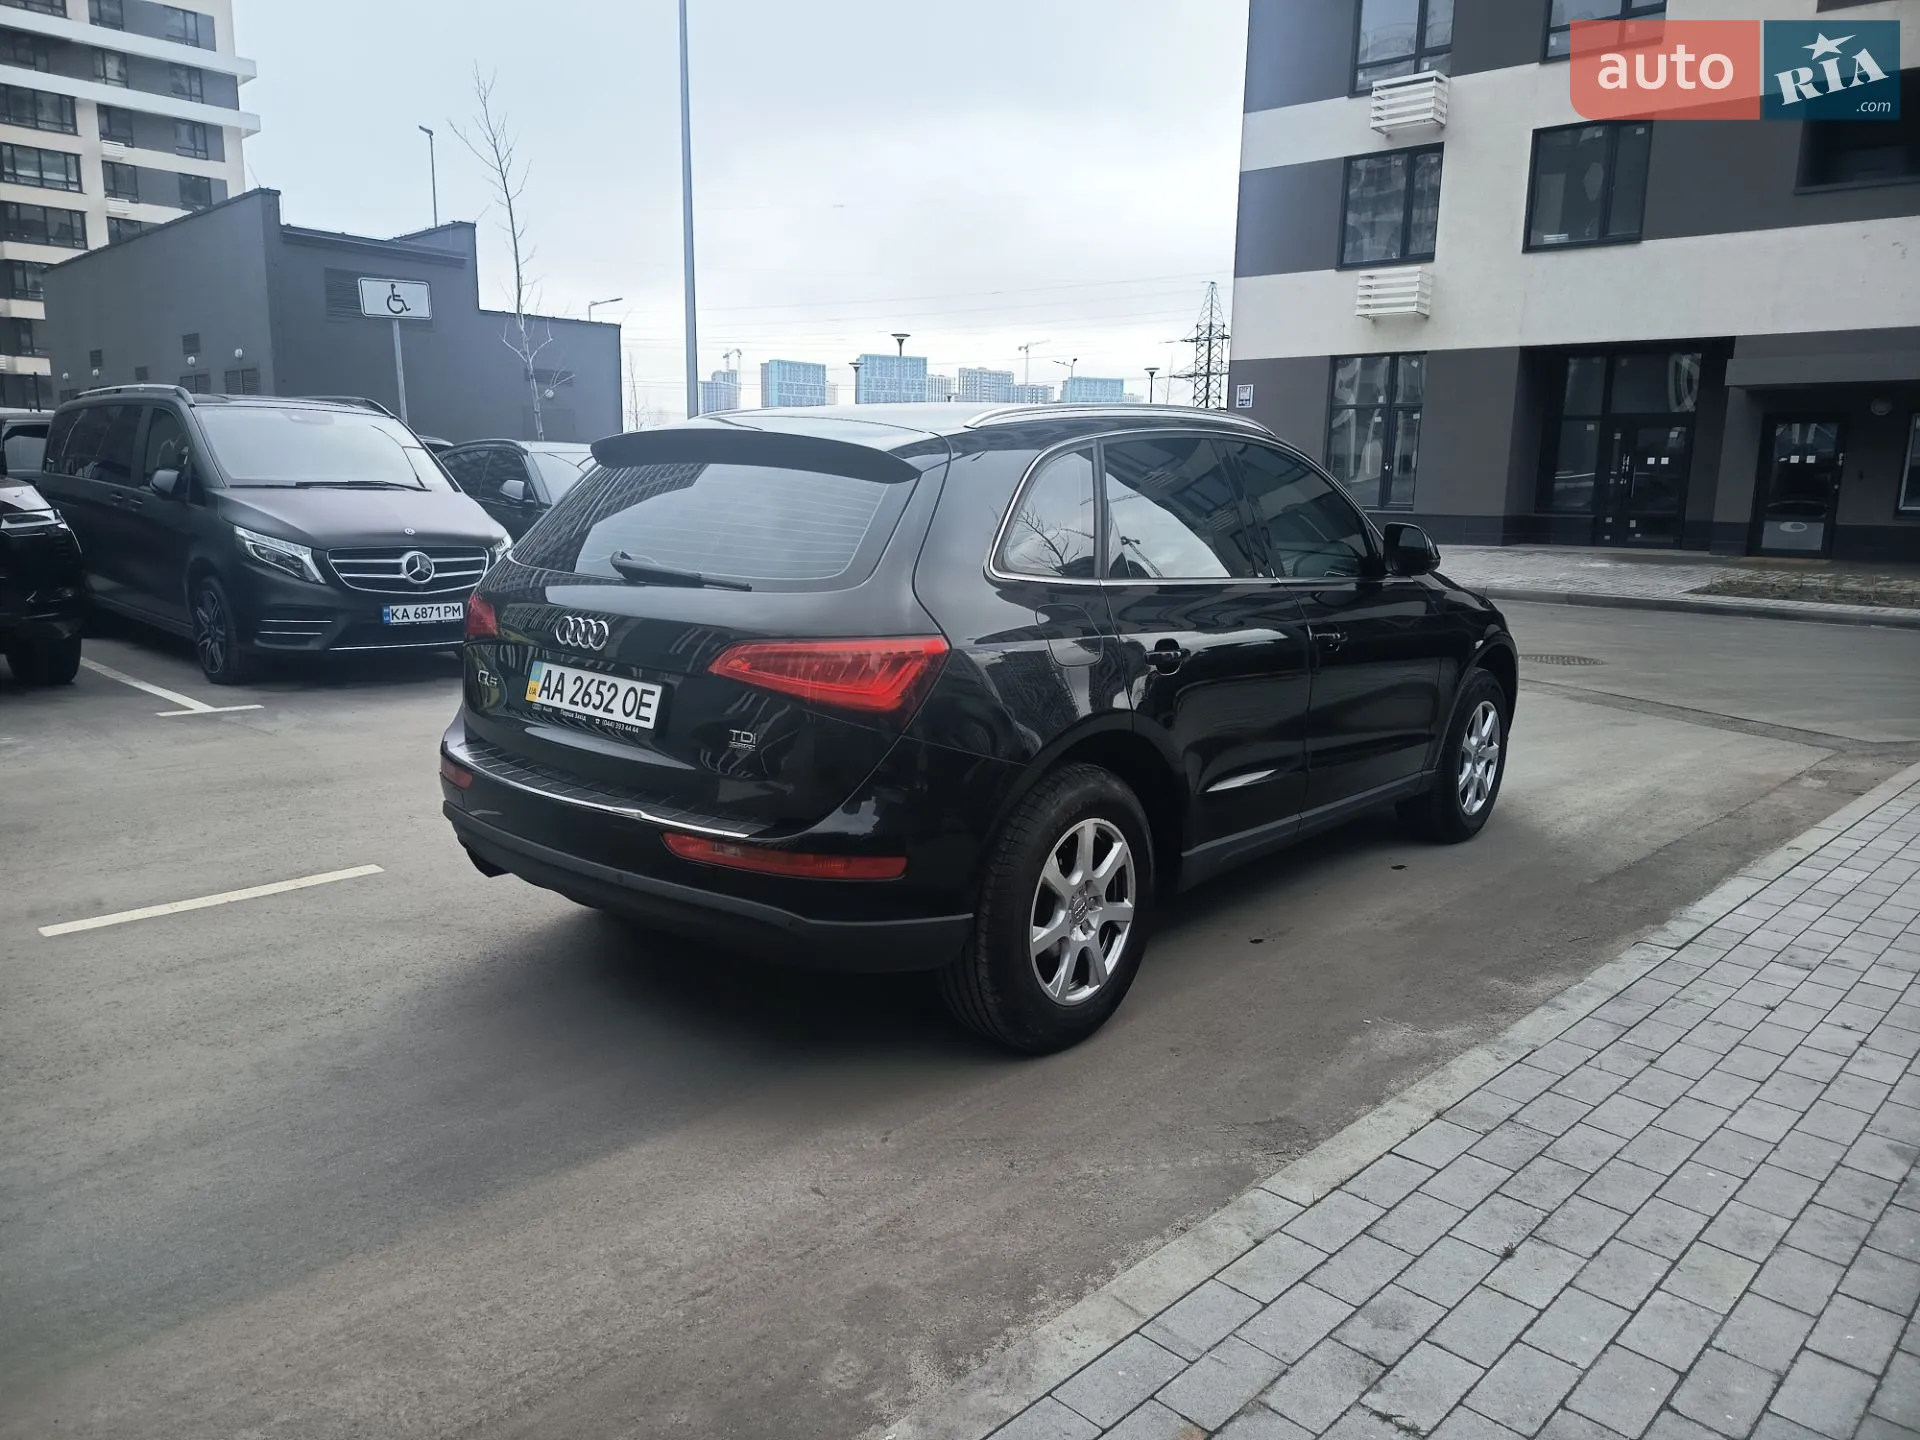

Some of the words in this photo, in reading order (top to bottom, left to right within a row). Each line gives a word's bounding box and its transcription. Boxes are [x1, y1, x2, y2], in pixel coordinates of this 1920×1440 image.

[390, 607, 410, 620] KA
[414, 606, 441, 619] 6871
[443, 605, 461, 617] PM
[477, 669, 498, 687] Q5
[528, 686, 537, 696] UA
[538, 669, 565, 703] AA
[568, 675, 618, 715] 2652
[622, 686, 656, 723] OE
[729, 729, 757, 745] TDI
